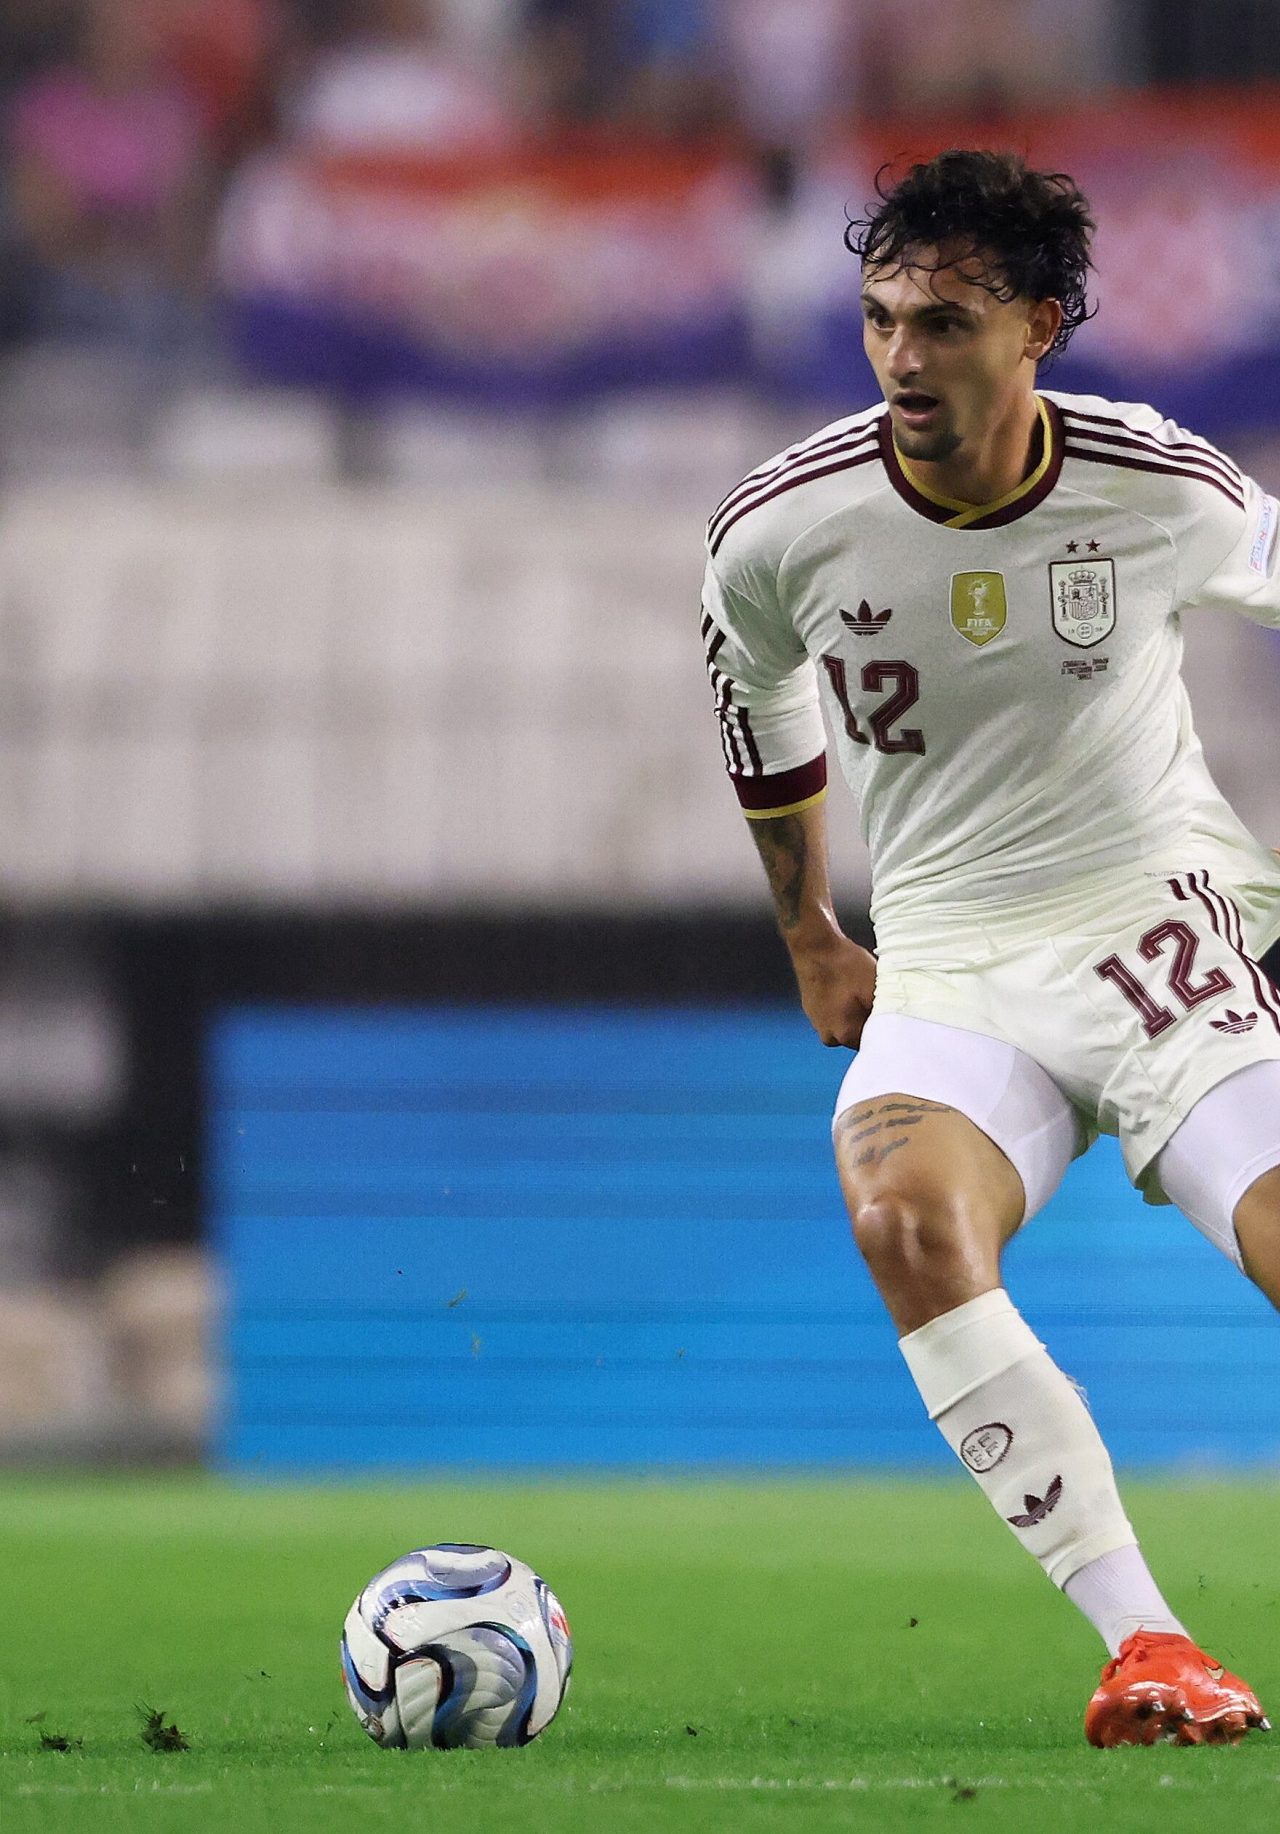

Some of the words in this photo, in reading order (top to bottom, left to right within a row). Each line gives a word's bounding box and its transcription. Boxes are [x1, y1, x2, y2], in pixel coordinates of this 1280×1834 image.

[966, 616, 992, 627] FIFA
[821, 653, 926, 756] 12
[1092, 918, 1236, 1041] 12
